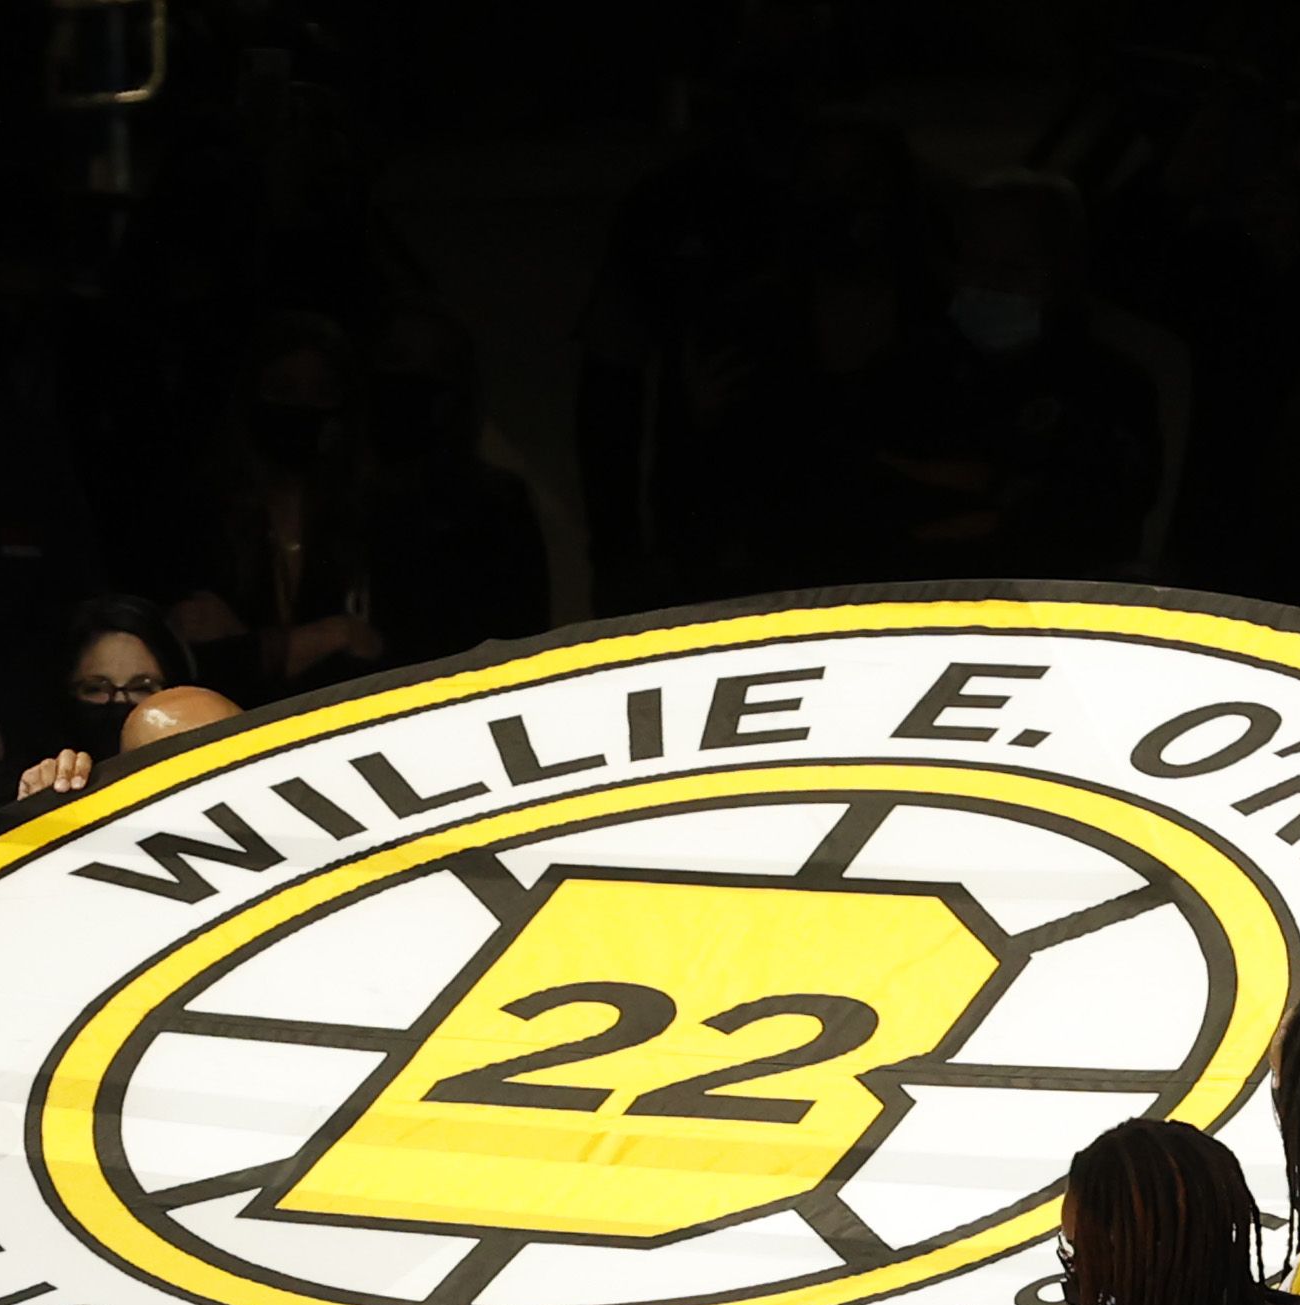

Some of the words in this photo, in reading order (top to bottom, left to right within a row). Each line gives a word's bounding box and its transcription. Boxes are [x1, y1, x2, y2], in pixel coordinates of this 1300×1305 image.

[68, 666, 826, 906] WILLIE
[891, 661, 1051, 748] E.
[420, 981, 880, 1124] 22
